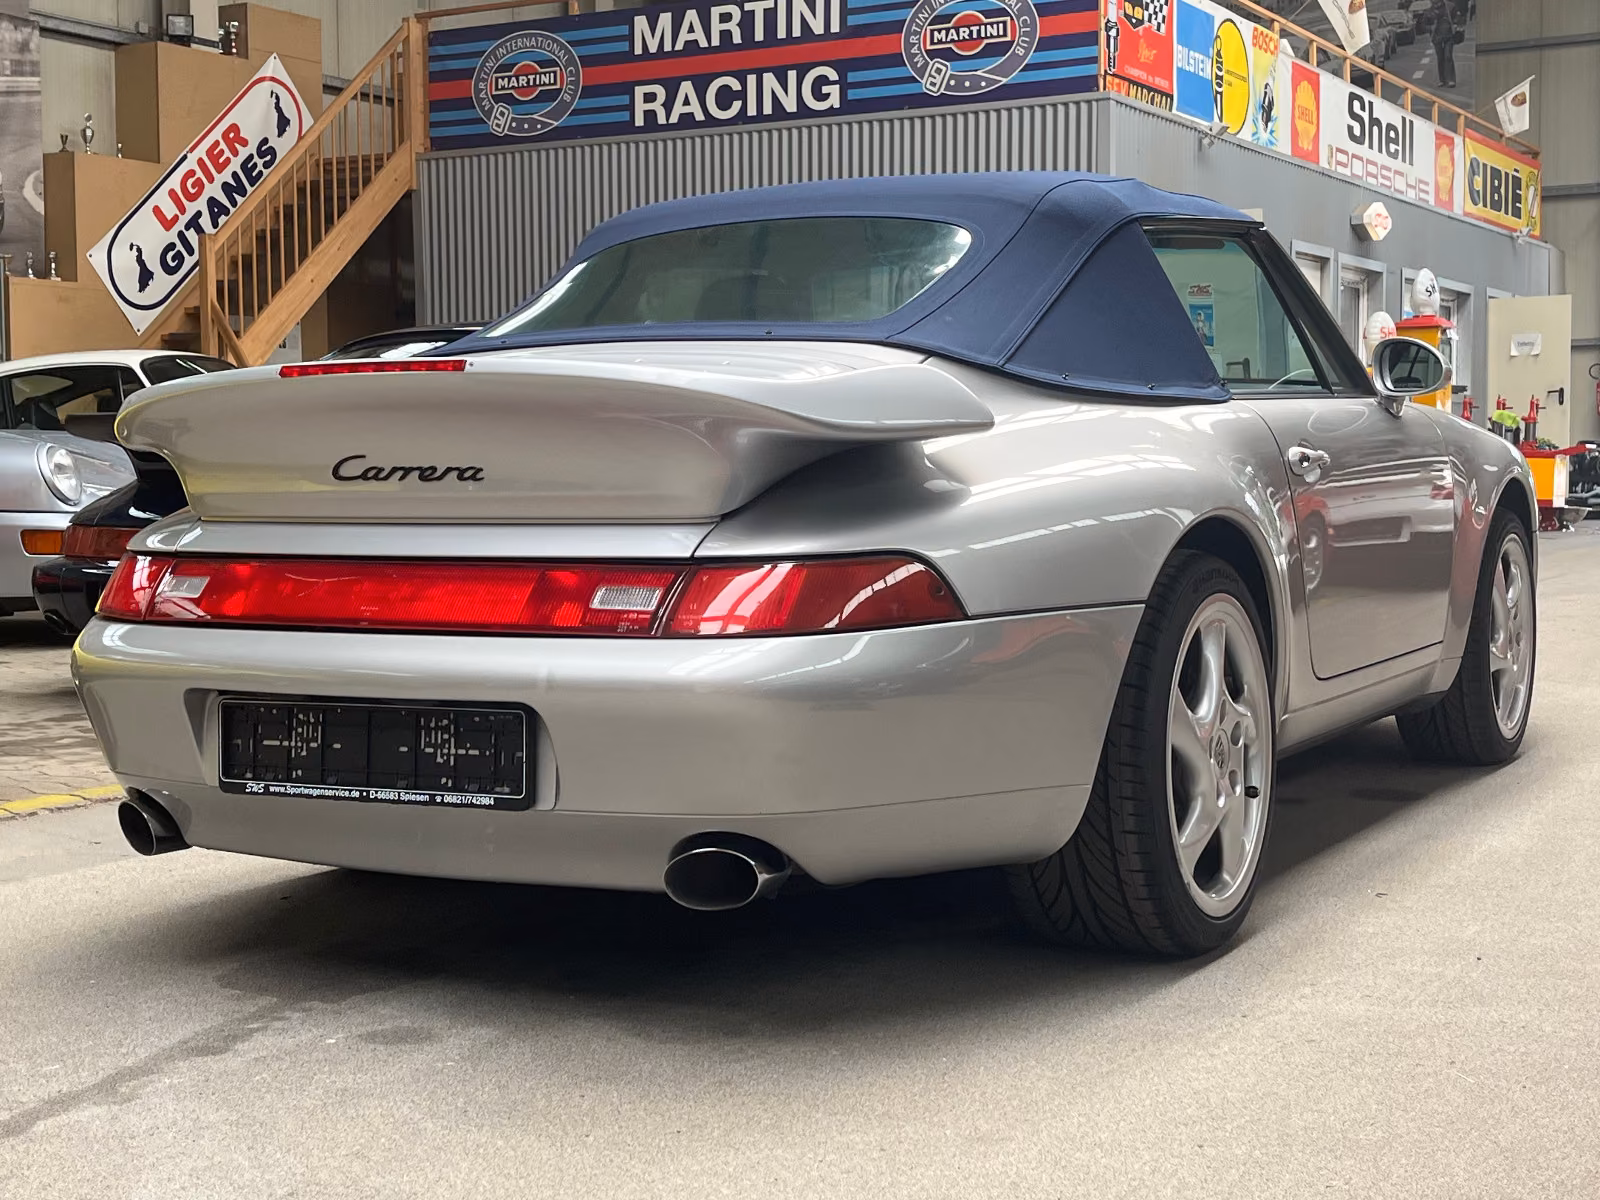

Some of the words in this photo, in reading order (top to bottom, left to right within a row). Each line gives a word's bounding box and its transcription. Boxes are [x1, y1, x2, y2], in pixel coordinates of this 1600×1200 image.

[634, 0, 840, 55] MARTINI
[910, 6, 932, 68] MARTINI
[1015, 15, 1031, 56] CLUB
[933, 23, 1004, 43] MARTINI
[1252, 26, 1279, 57] BOSCH
[479, 55, 497, 111] MARTINI
[496, 37, 569, 65] INTERNATIONAL
[563, 67, 575, 102] CLUB
[498, 72, 555, 89] MARTINI
[1177, 44, 1212, 80] BILSTEIN
[634, 66, 840, 127] RACING
[1297, 103, 1314, 126] SHELL
[1347, 91, 1414, 167] Shell
[152, 122, 249, 232] LIGIER
[1334, 146, 1430, 204] PORSCHE
[159, 136, 277, 276] GITANES
[331, 455, 485, 482] Carrera
